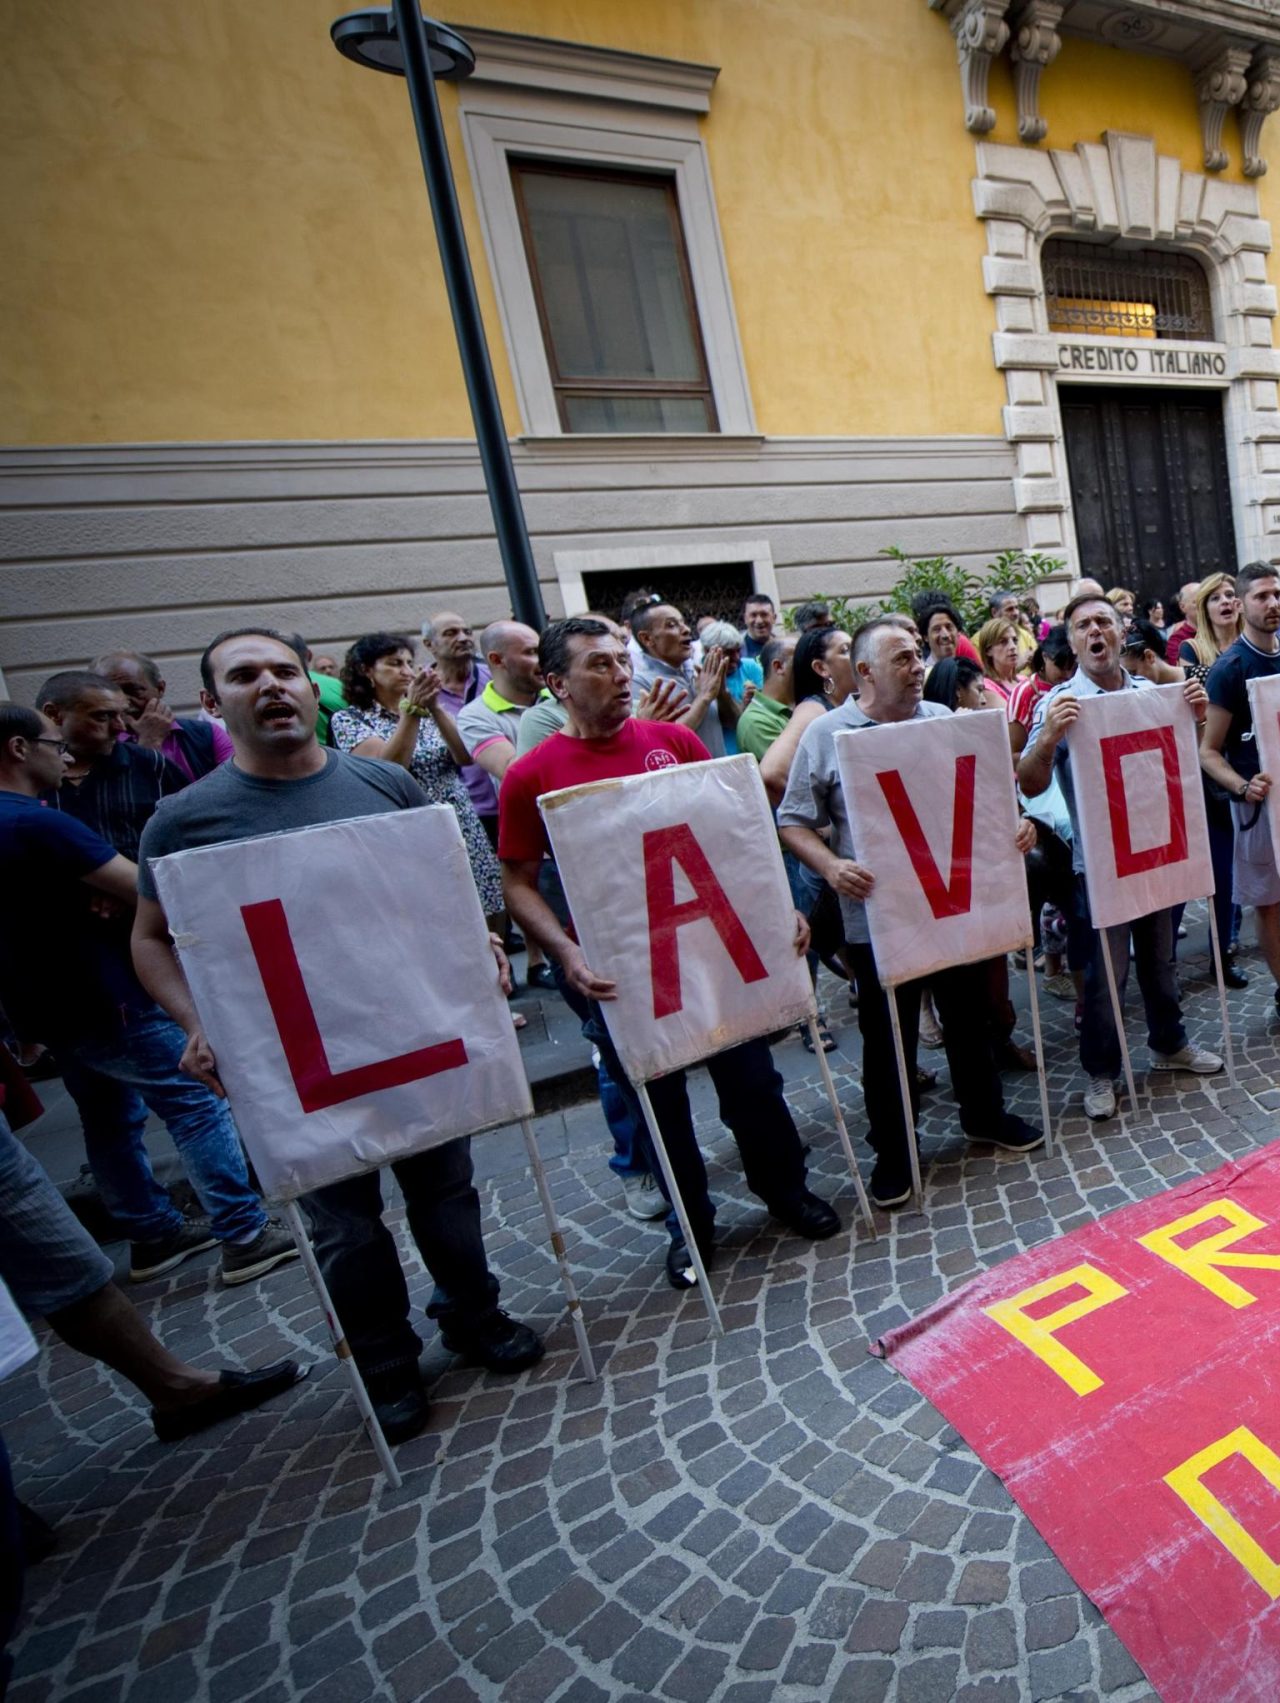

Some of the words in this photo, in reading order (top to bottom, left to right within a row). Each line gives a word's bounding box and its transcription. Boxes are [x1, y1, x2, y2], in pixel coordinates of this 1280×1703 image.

[1058, 345, 1139, 372] CREDITO
[1149, 349, 1227, 376] ITALIANO
[240, 898, 469, 1114] L
[643, 823, 769, 1019] A
[875, 754, 976, 920] V
